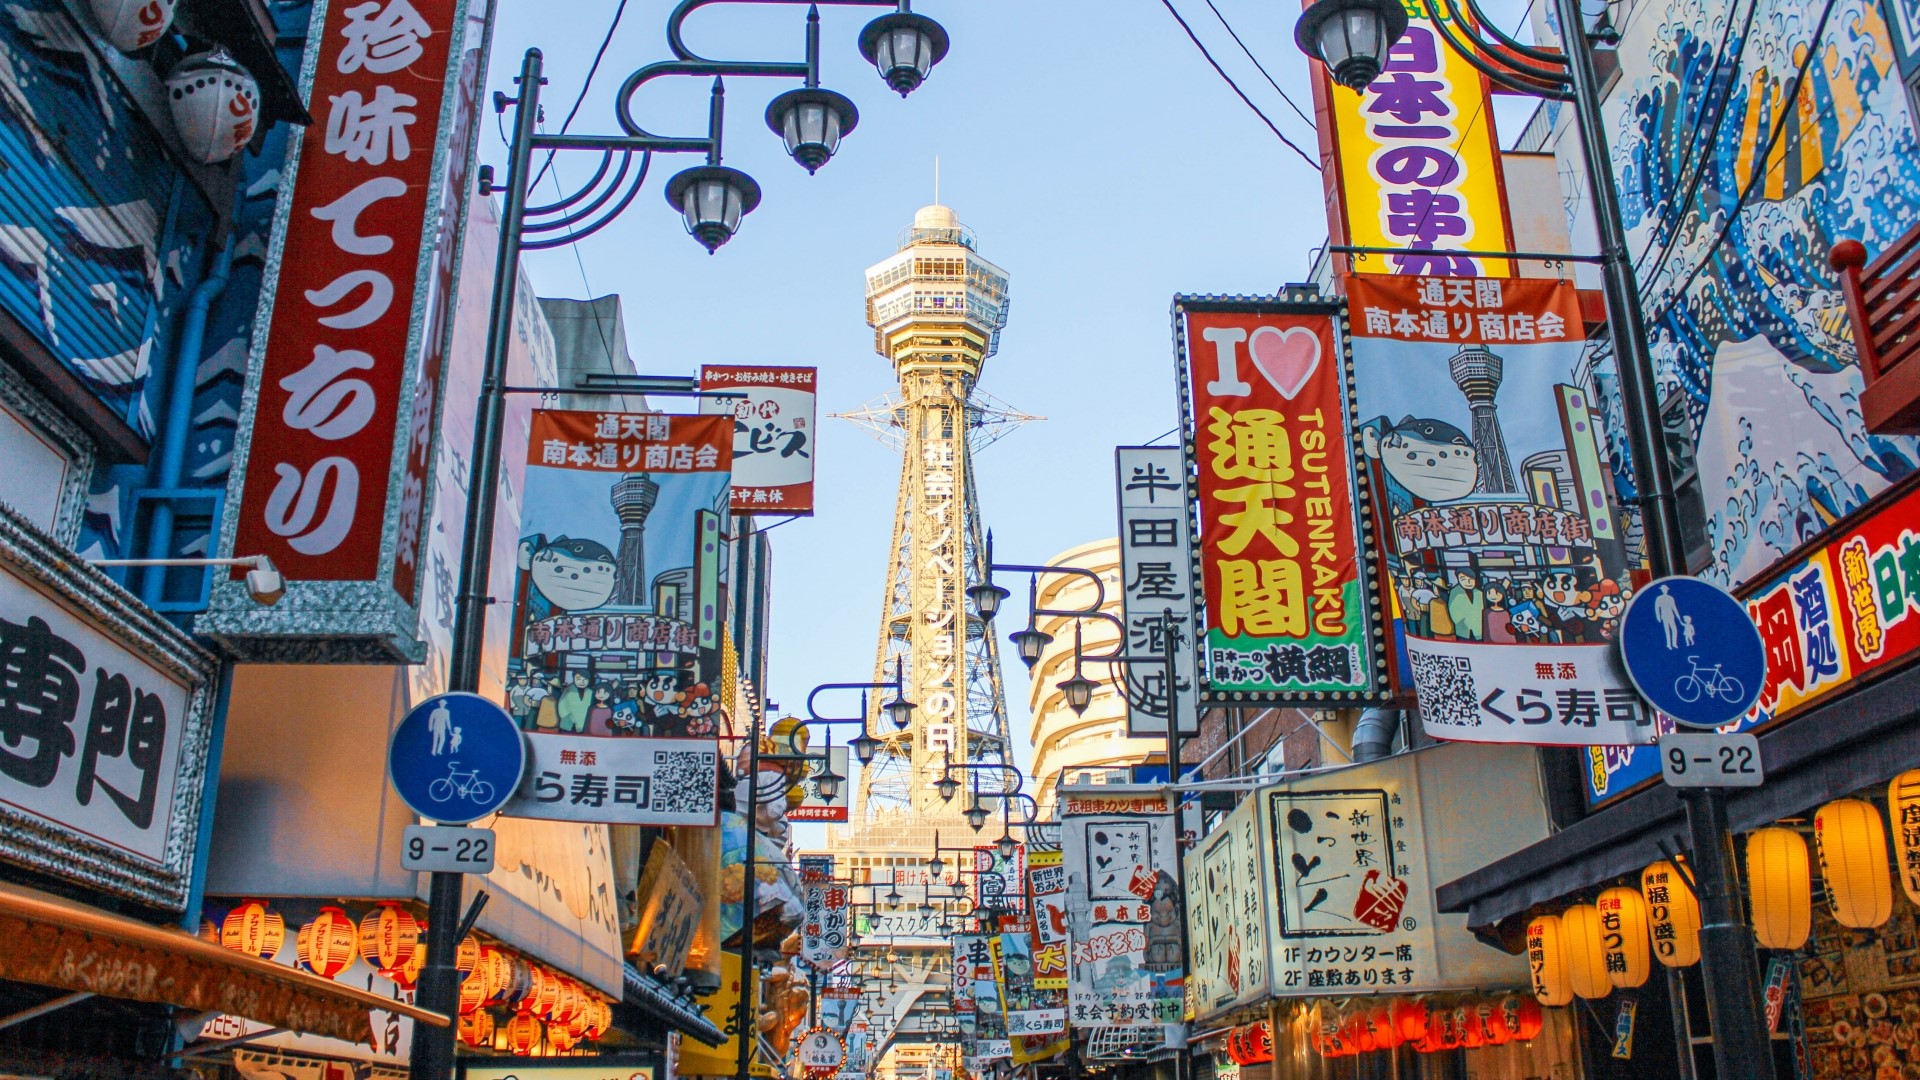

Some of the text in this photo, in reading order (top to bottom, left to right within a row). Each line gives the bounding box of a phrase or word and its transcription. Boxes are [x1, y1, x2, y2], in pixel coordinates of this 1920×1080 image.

[262, 0, 432, 556] 珍味てっちり
[1417, 277, 1504, 308] 通天閣
[1363, 306, 1566, 341] 南本通り商店会
[704, 369, 813, 384] 串かつ・お好み焼き・焼きそば
[1202, 326, 1252, 398] I
[735, 399, 780, 419] 初代
[594, 414, 671, 441] 通天閣
[542, 439, 720, 470] 南本通り商店会
[1206, 405, 1308, 637] 通天閣
[1297, 407, 1346, 635] TSUTENKAKU
[1397, 508, 1590, 542] 南本通り商店街
[1843, 541, 1882, 655] 新世界
[529, 618, 698, 651] 南本通り商店街
[1793, 567, 1839, 685] 酒処
[1213, 650, 1264, 664] 日本一の
[1214, 666, 1265, 683] 串かつ
[1264, 644, 1352, 685] 横綱
[1534, 662, 1578, 680] 無添
[1480, 687, 1652, 728] くら寿司
[559, 749, 597, 767] 無添
[1348, 808, 1379, 867] 新世界
[1390, 792, 1410, 877] 商標登録
[822, 886, 847, 947] 串かつ
[1599, 898, 1622, 911] 元祖
[1648, 886, 1676, 956] 握り盛り
[247, 913, 259, 952] アサヒビール
[315, 923, 328, 962] アサヒビール
[383, 919, 393, 958] アサヒビール
[1072, 929, 1148, 965] 大阪名物
[1602, 911, 1627, 973] もつ鍋
[1284, 944, 1413, 964] 1F カウンター席
[1528, 936, 1549, 997] 横綱ソース
[1284, 967, 1415, 988] 2F 座敷あります
[1025, 1018, 1065, 1031] くら寿司
[1074, 1003, 1180, 1021] 宴会予約受付中
